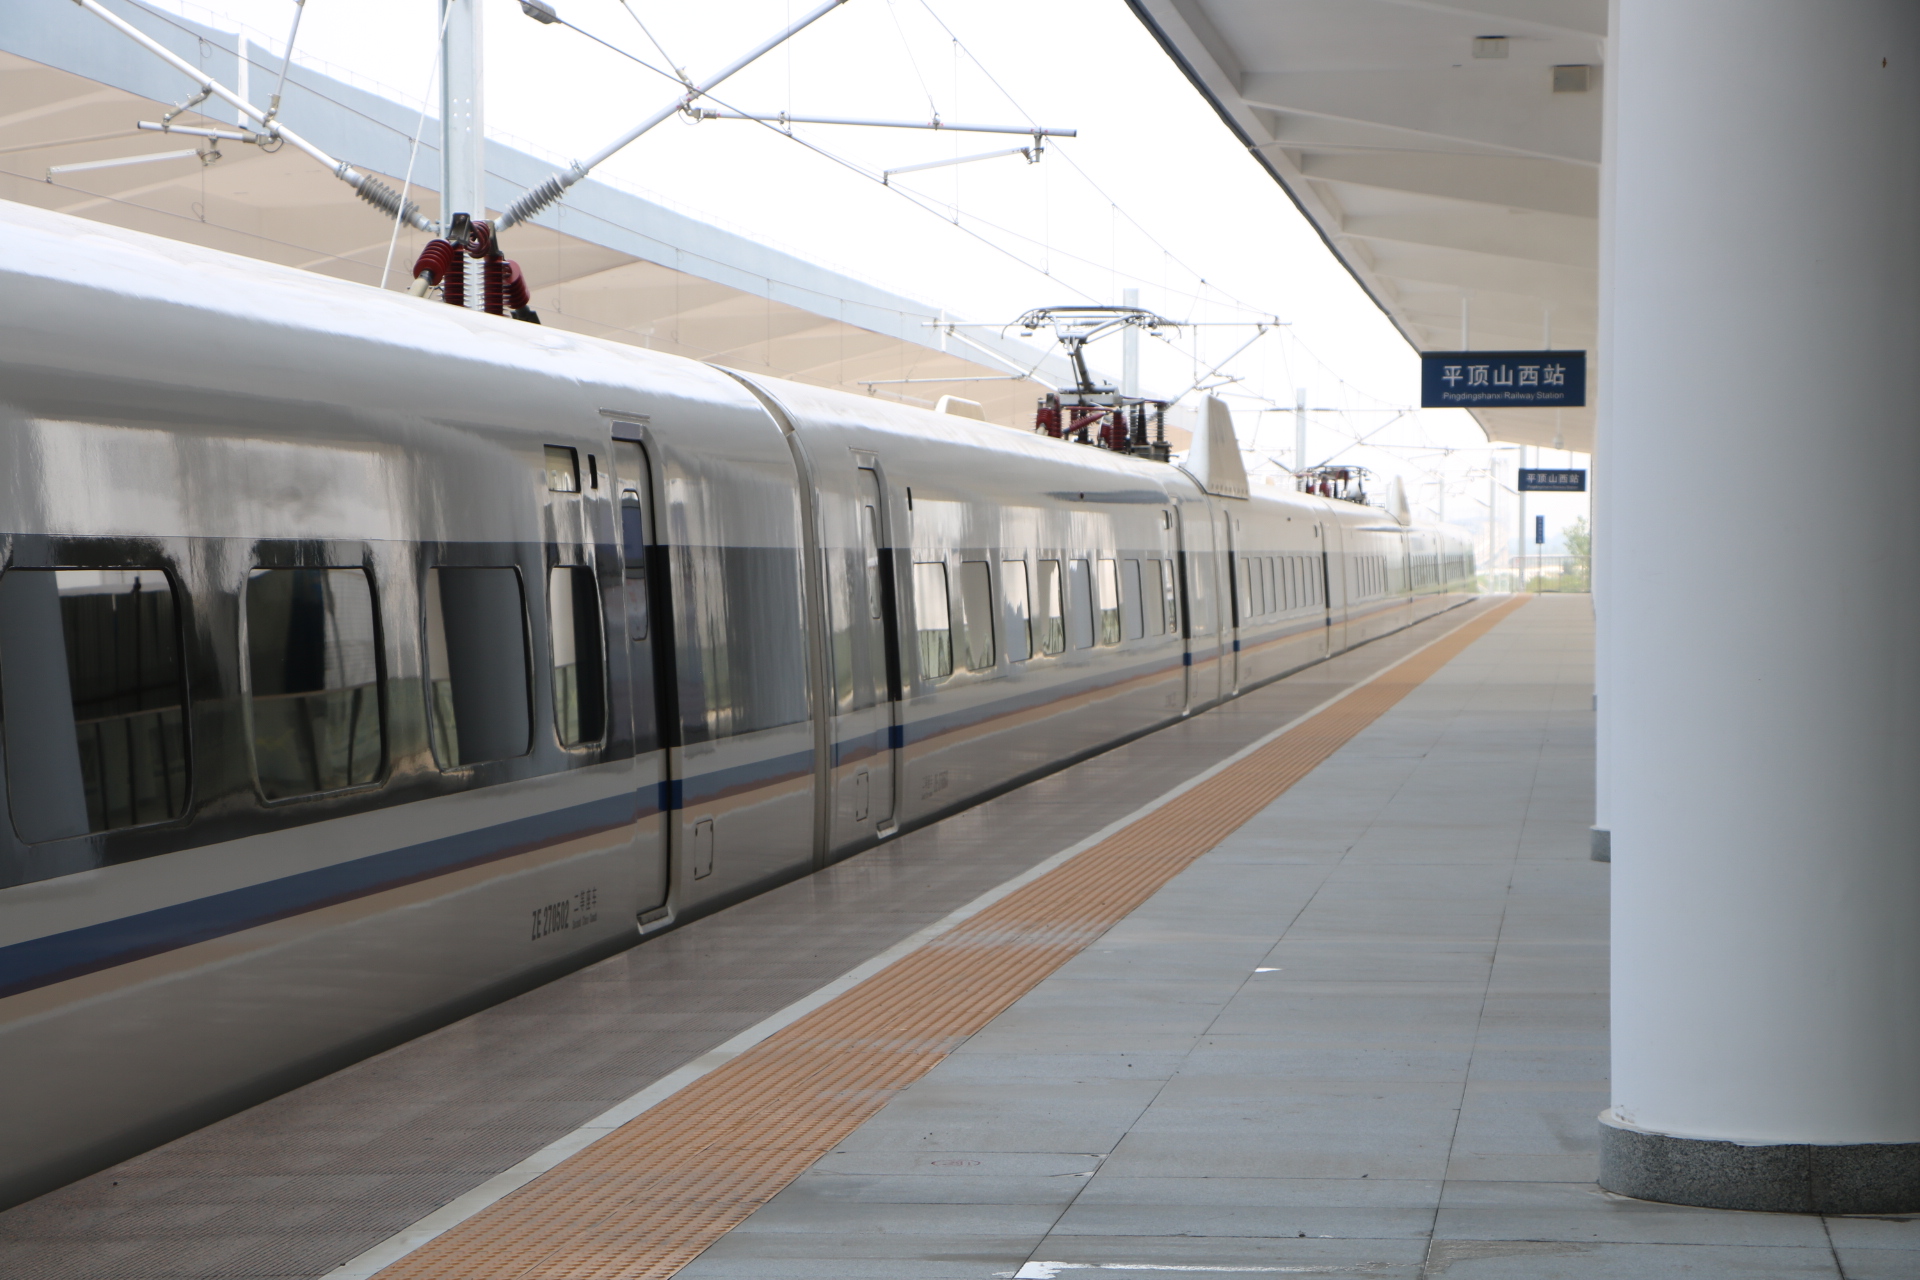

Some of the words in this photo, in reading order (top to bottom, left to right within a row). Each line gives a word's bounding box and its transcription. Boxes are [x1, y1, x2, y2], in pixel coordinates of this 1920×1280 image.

[1442, 363, 1566, 387] 平顶山西站
[1443, 392, 1502, 401] Pingdingshanxi
[1504, 391, 1534, 401] Railway
[1536, 391, 1564, 400] Station
[1526, 473, 1579, 484] 平顶山西站
[531, 908, 542, 941] ZE
